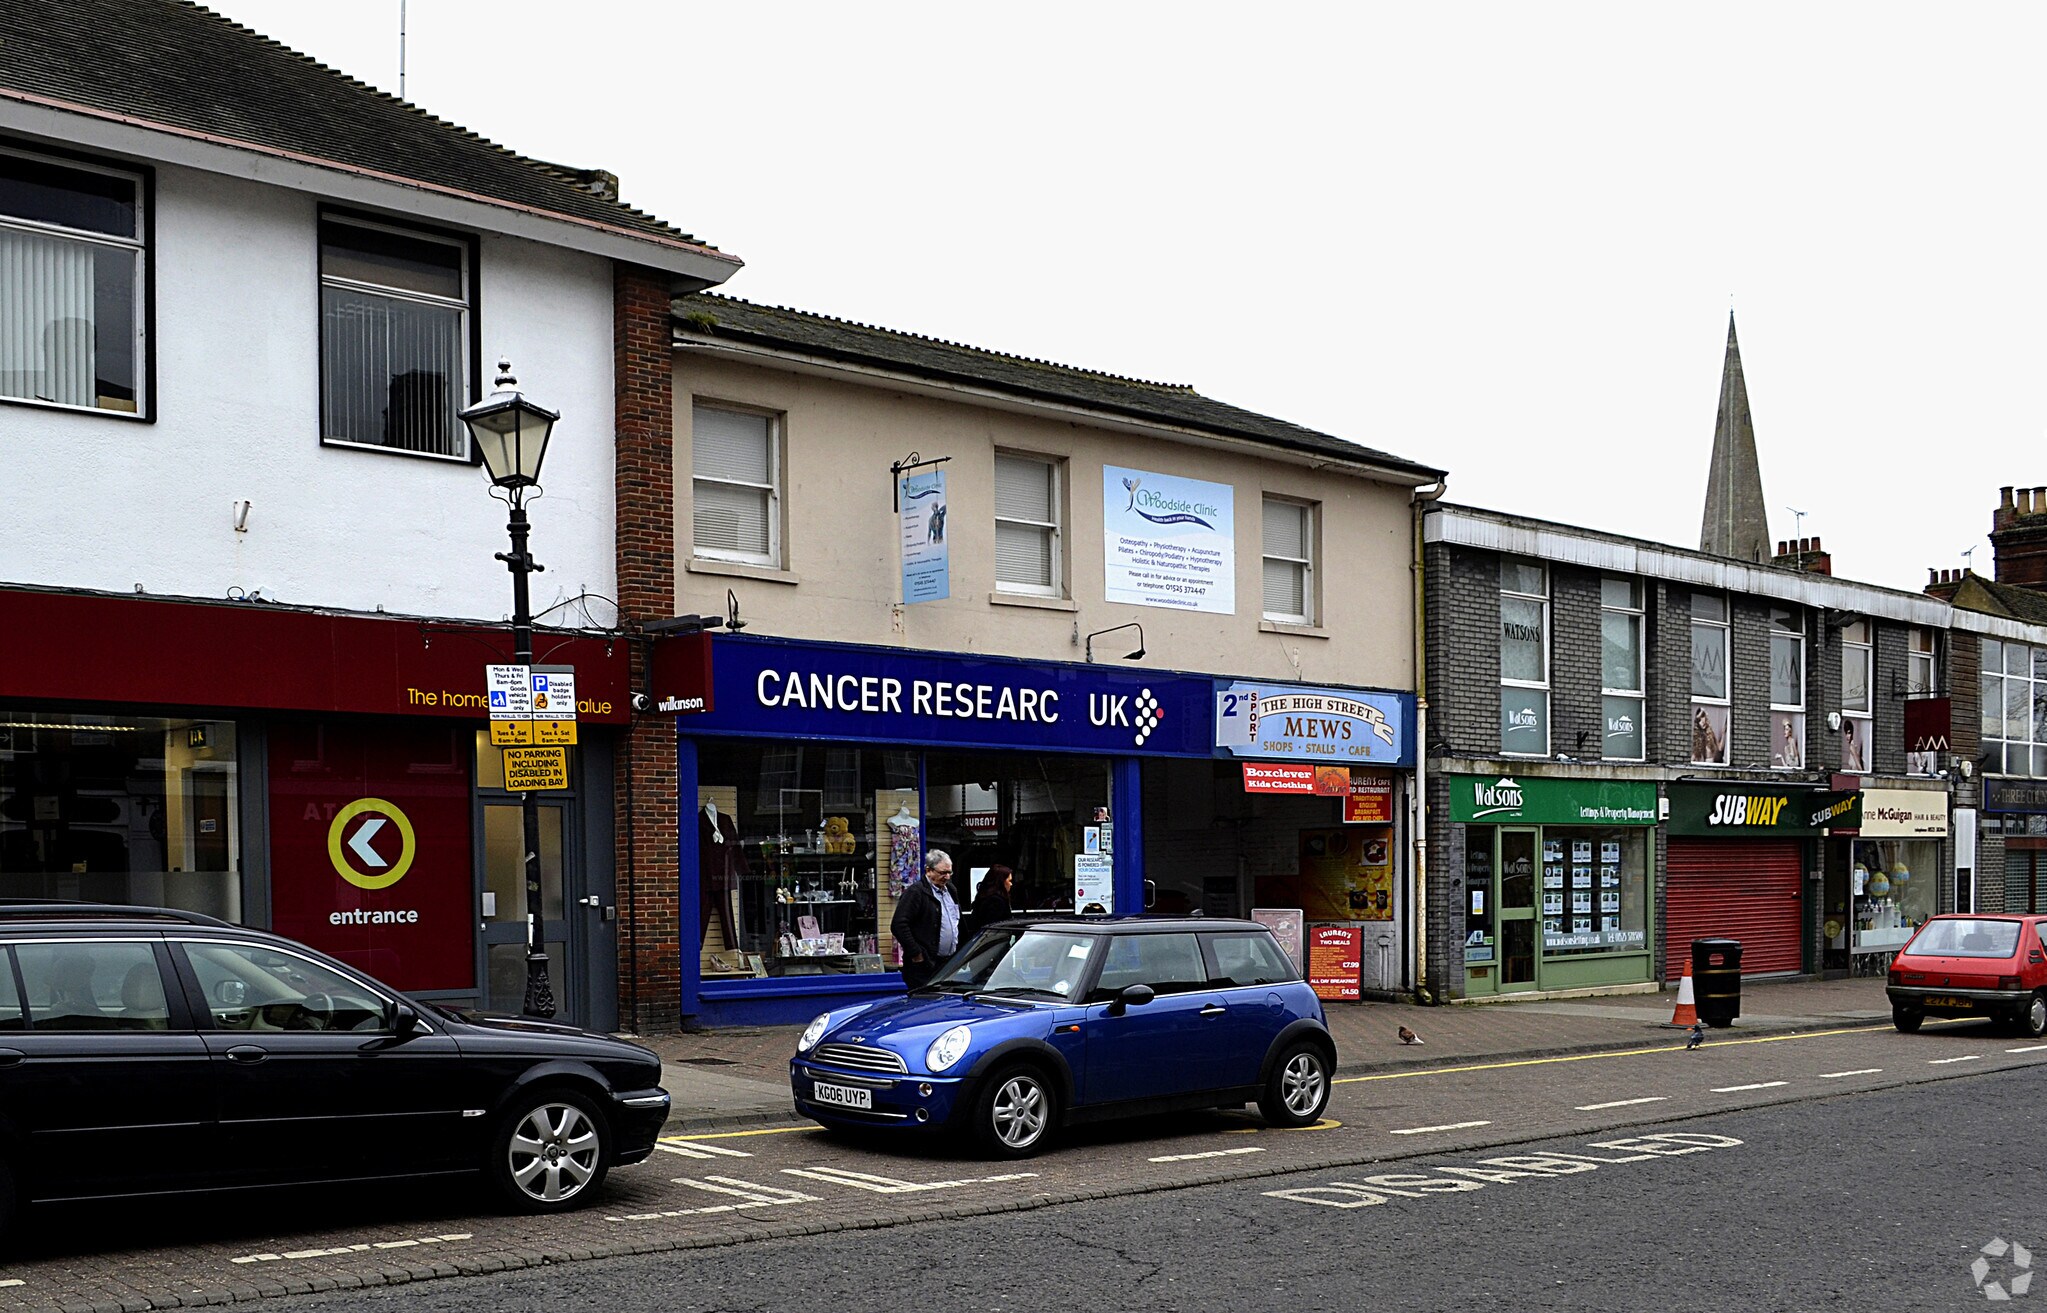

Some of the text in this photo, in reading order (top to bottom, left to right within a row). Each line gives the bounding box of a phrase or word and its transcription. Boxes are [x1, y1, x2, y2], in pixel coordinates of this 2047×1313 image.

[1137, 489, 1217, 517] Woodside Clinic
[1120, 538, 1220, 556] Osteopathy Physiotherapy Acupuncture
[1132, 557, 1150, 565] Holistic
[1157, 561, 1187, 569] Naturopathic
[1188, 564, 1210, 572] Therapies
[1190, 556, 1222, 566] Hypnotherapy
[1166, 584, 1182, 592] 01525
[1504, 623, 1540, 642] WATSONS
[535, 677, 546, 690] P
[407, 688, 437, 705] The
[575, 698, 612, 714] alue
[658, 696, 703, 712] wilkinson
[757, 669, 1130, 727] CANCER RESEARC UK
[1261, 698, 1373, 719] THE HIGH STREET
[1249, 693, 1257, 742] SPORT
[1509, 711, 1537, 725] Watsons
[1608, 718, 1633, 732] Watsons
[1283, 716, 1351, 740] MEWS
[524, 750, 561, 758] PARKING
[1263, 741, 1293, 752] SHOPS
[1306, 744, 1335, 754] STALLS
[512, 760, 558, 768] INCLUDING
[509, 769, 551, 778] DISABLED
[1246, 767, 1312, 778] Boxclever
[508, 778, 564, 787] LOADING BAY
[1248, 780, 1313, 790] Kids Clothing
[1474, 783, 1523, 807] Watsons
[2000, 788, 2025, 803] THREE
[1580, 806, 1599, 820] Lettings
[1605, 807, 1627, 820] Property
[1709, 795, 1788, 825] SUBWAY
[1810, 796, 1856, 826] SUBWAY
[1877, 808, 1912, 823] McGuigan
[1503, 861, 1532, 874] Watsons
[329, 908, 418, 925] entrance
[1319, 930, 1352, 939] LAUREN'S
[818, 1084, 866, 1105] KG06 UYP
[1261, 1132, 1744, 1208] DISABLED
